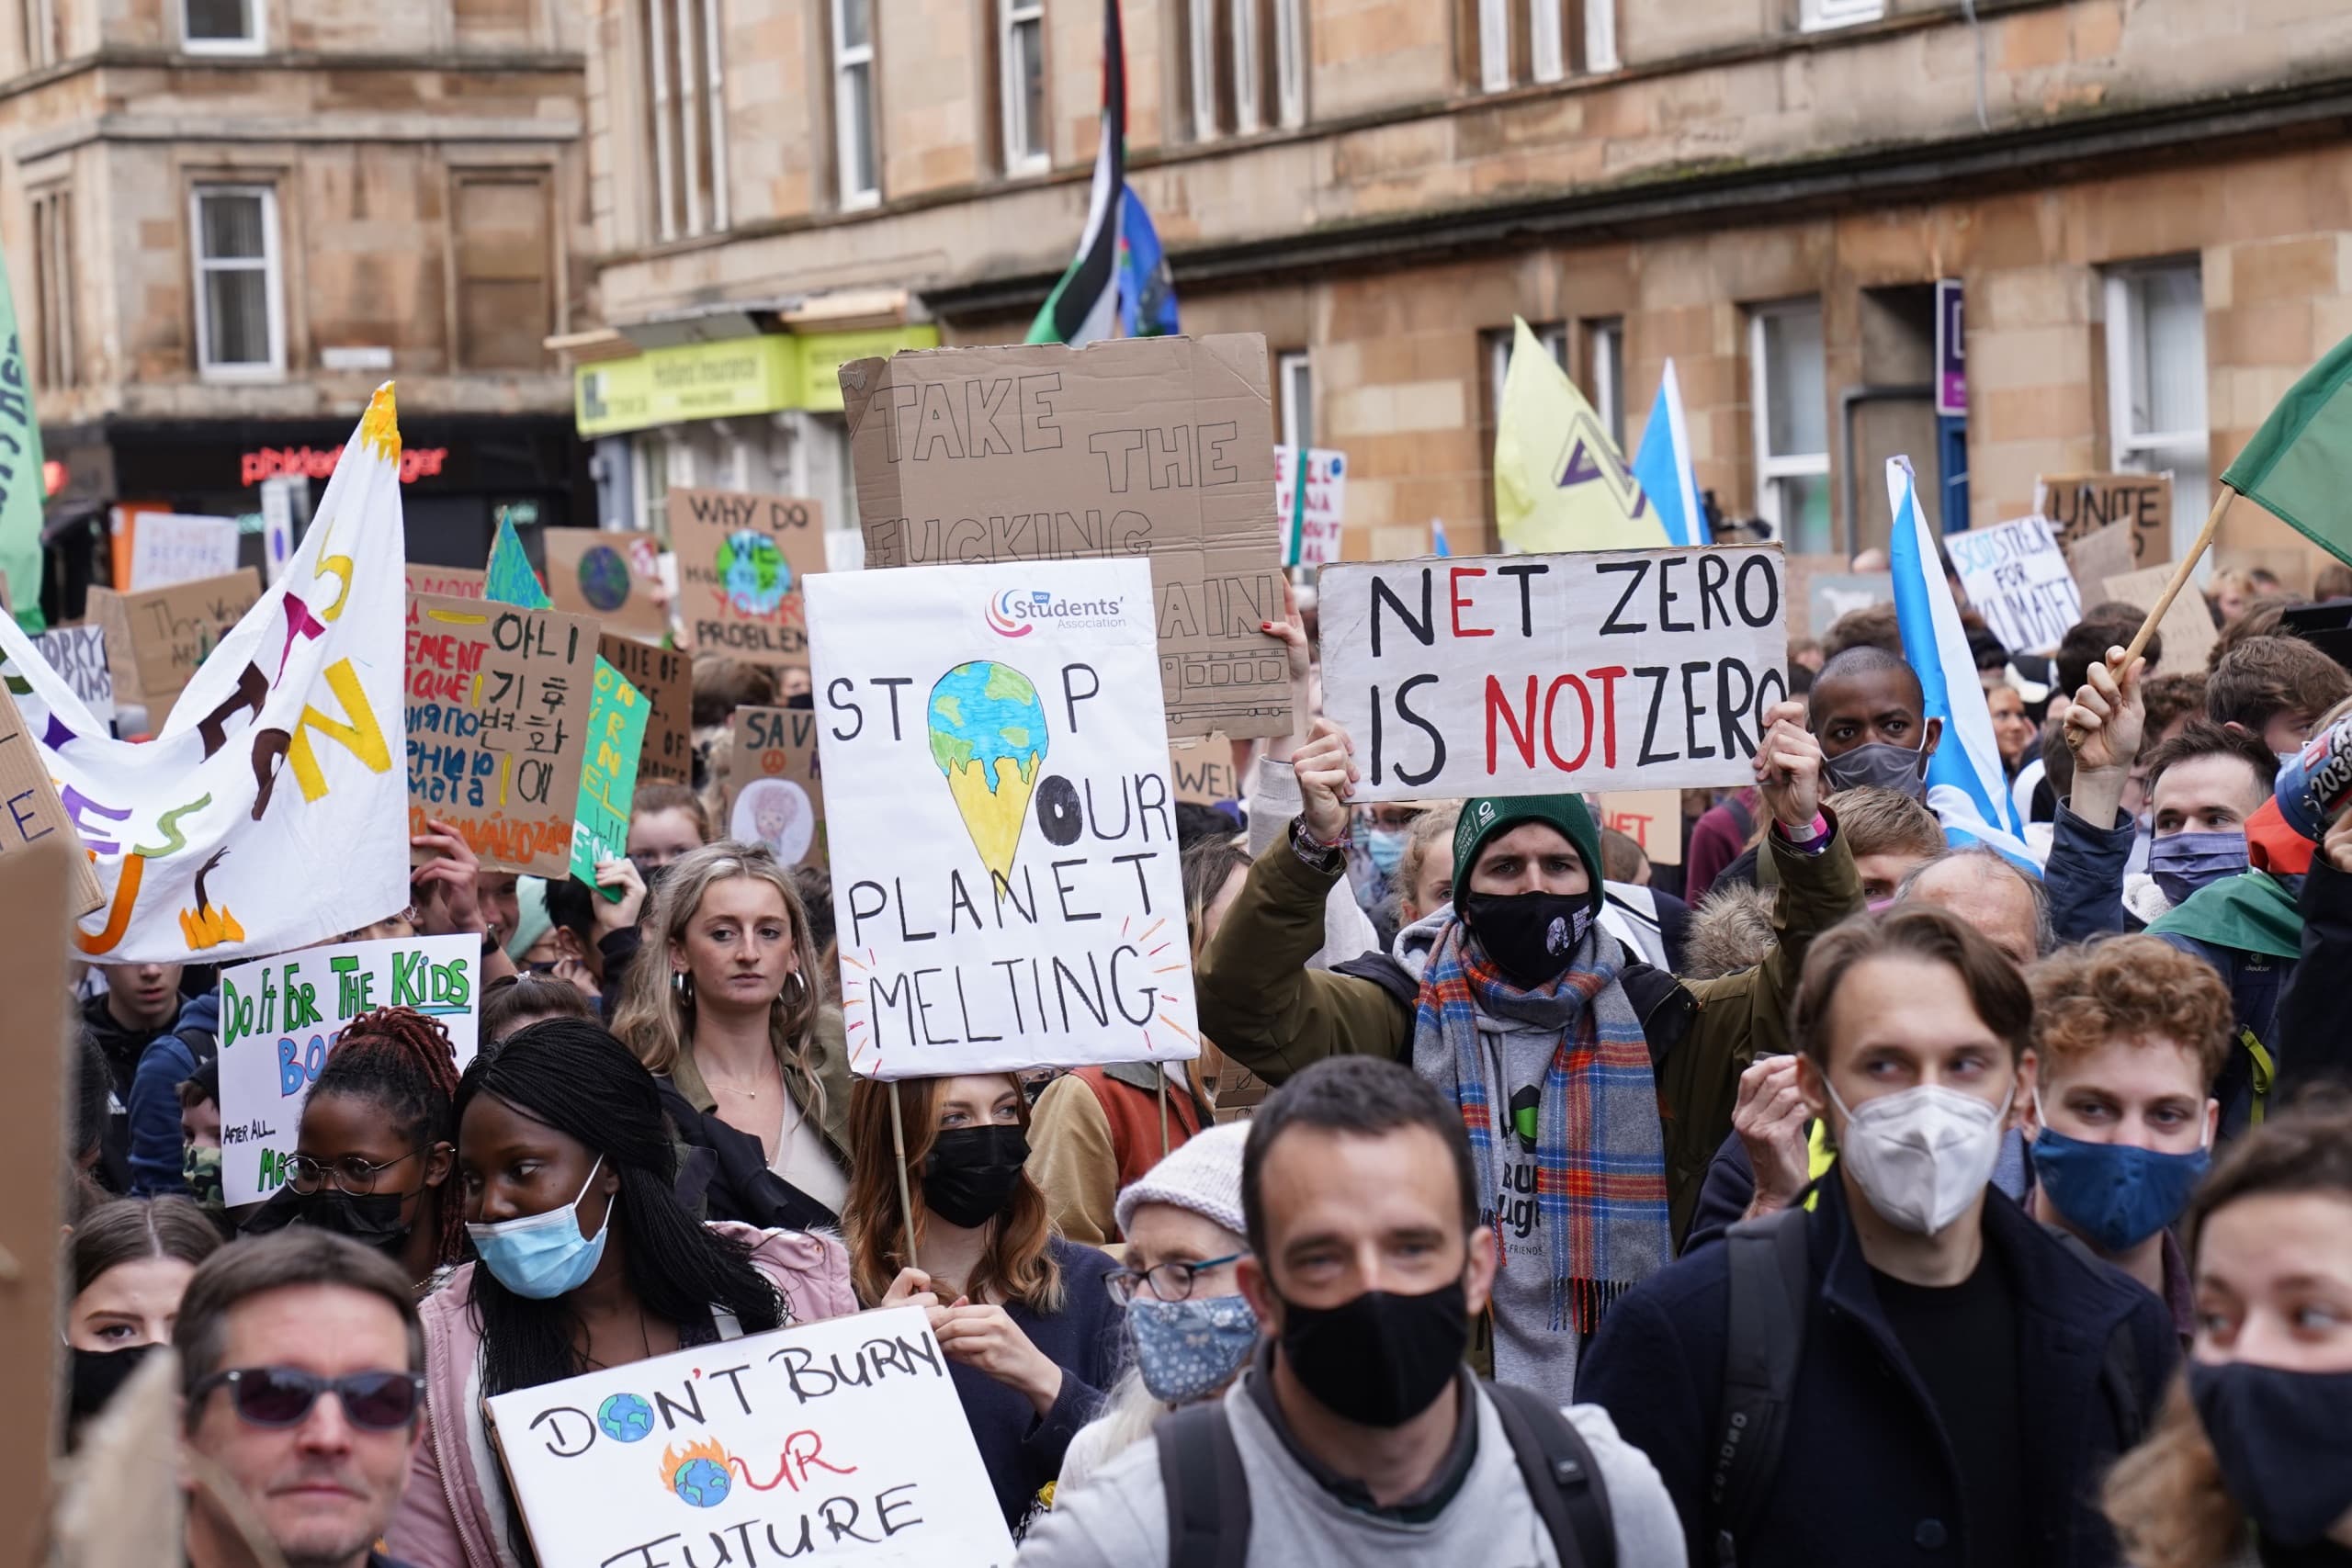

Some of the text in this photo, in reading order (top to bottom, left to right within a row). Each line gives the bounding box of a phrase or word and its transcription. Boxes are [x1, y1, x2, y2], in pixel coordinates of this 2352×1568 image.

[871, 371, 1238, 493] TAKE THE
[689, 495, 808, 531] WHY DO
[2053, 486, 2161, 528] UNITE
[1013, 595, 1125, 619] Students'
[1057, 617, 1127, 630] Association
[1158, 574, 1277, 639] AIN
[1370, 553, 1779, 658] NET ZERO
[659, 653, 680, 684] OF
[663, 730, 685, 759] OF
[745, 711, 818, 750] SAV
[1370, 655, 1788, 787] IS NOT ZERO
[1035, 773, 1172, 847] OUR
[847, 852, 1159, 947] PLANET
[868, 943, 1159, 1049] MELTING
[222, 1123, 249, 1145] AFTER
[767, 1329, 944, 1404] BURN
[600, 1482, 924, 1568] FUTURE
